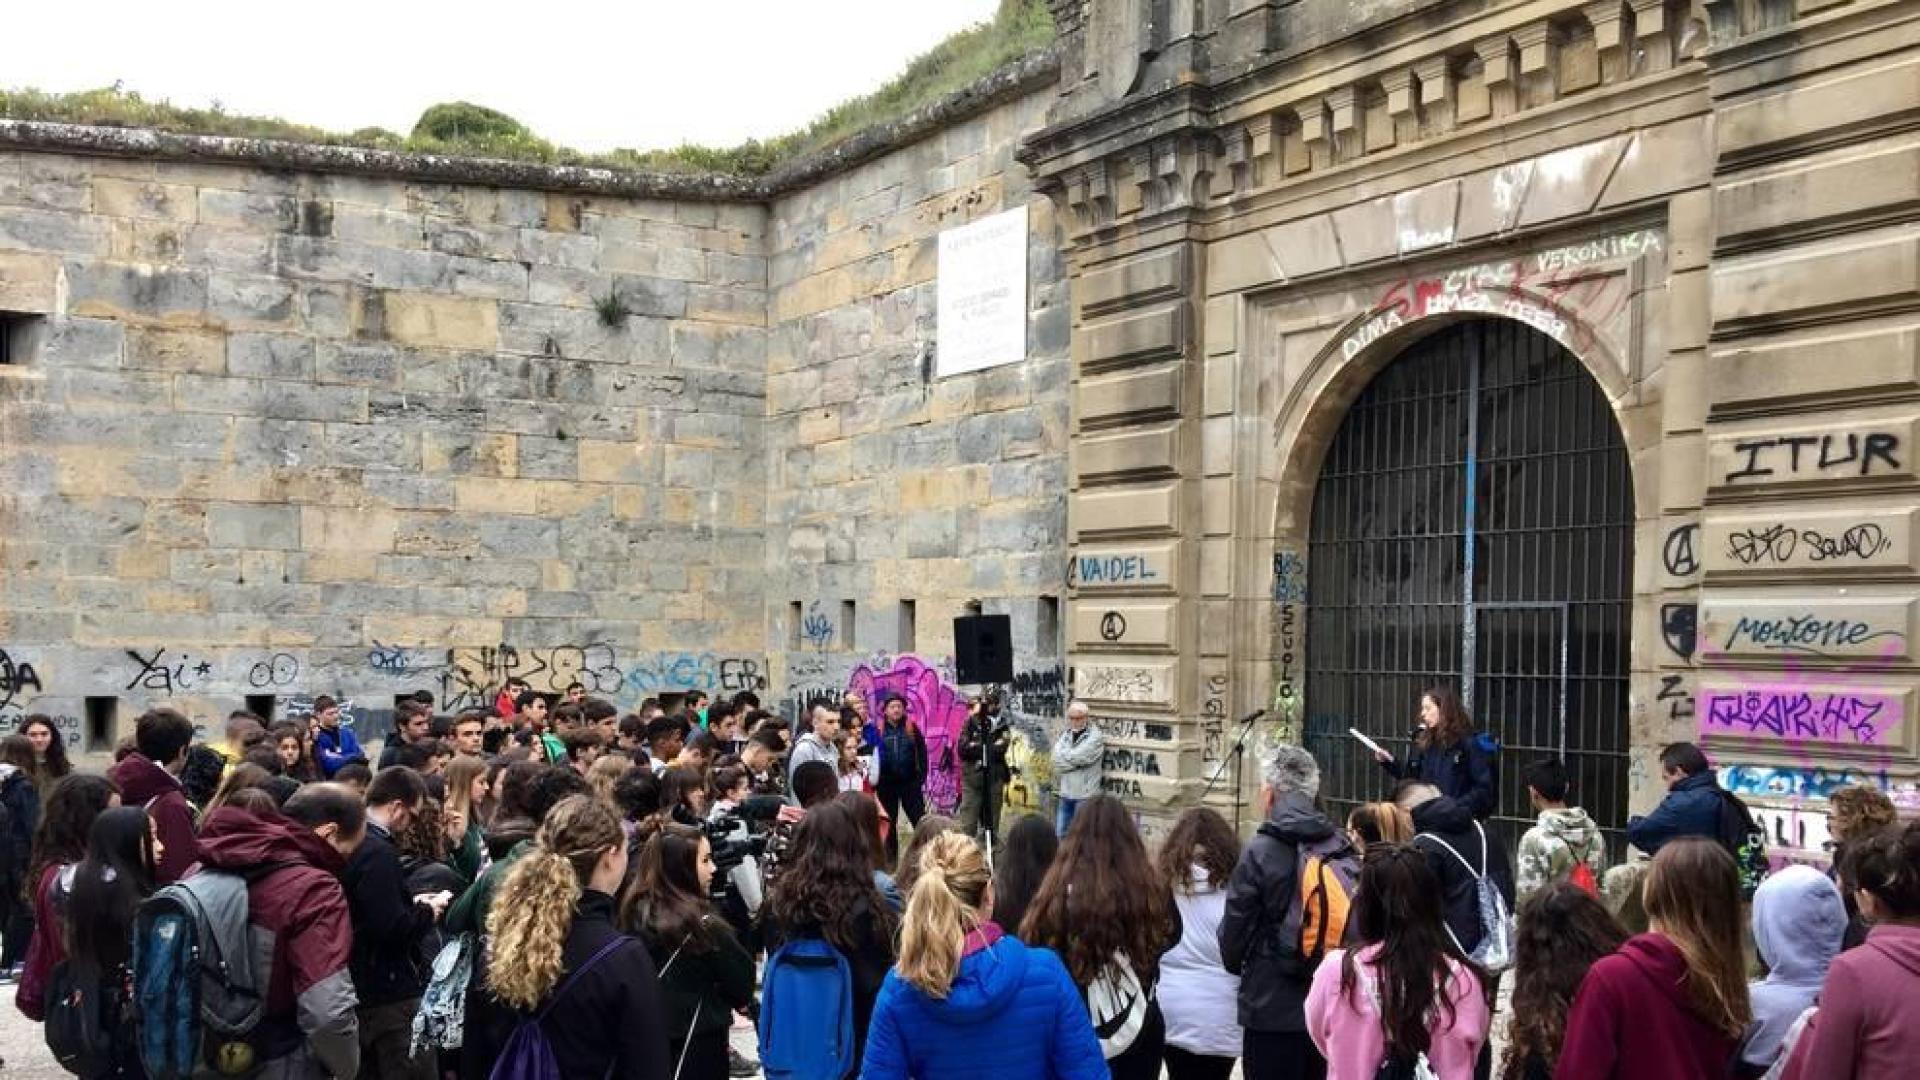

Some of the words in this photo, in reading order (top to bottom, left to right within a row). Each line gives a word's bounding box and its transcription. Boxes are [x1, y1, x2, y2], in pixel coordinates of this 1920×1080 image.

[1537, 231, 1661, 271] VERONIKA
[1725, 433, 1900, 482] ITUR
[1080, 556, 1156, 582] VAIDEL
